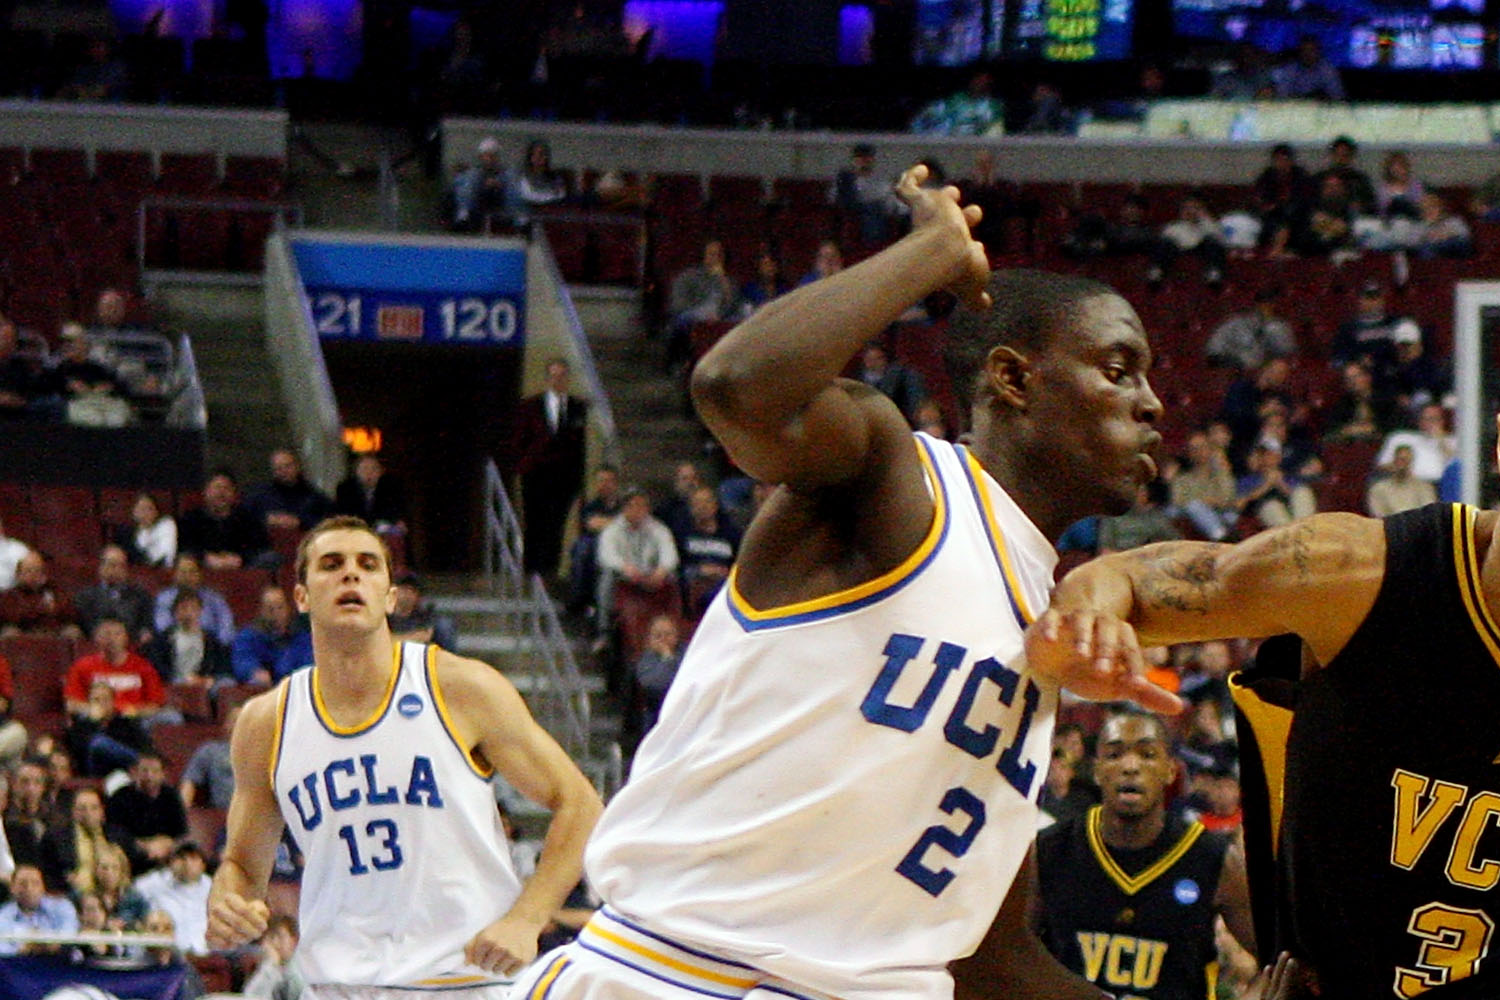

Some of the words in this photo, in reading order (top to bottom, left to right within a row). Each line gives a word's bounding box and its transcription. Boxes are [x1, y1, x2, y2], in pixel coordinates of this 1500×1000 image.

[309, 294, 362, 335] 21
[441, 299, 517, 341] 120
[860, 633, 1046, 806] UCL
[288, 754, 444, 831] UCLA
[338, 819, 404, 875] 13
[895, 787, 986, 898] 2
[1076, 931, 1169, 989] VCU
[1393, 901, 1495, 1000] 3
